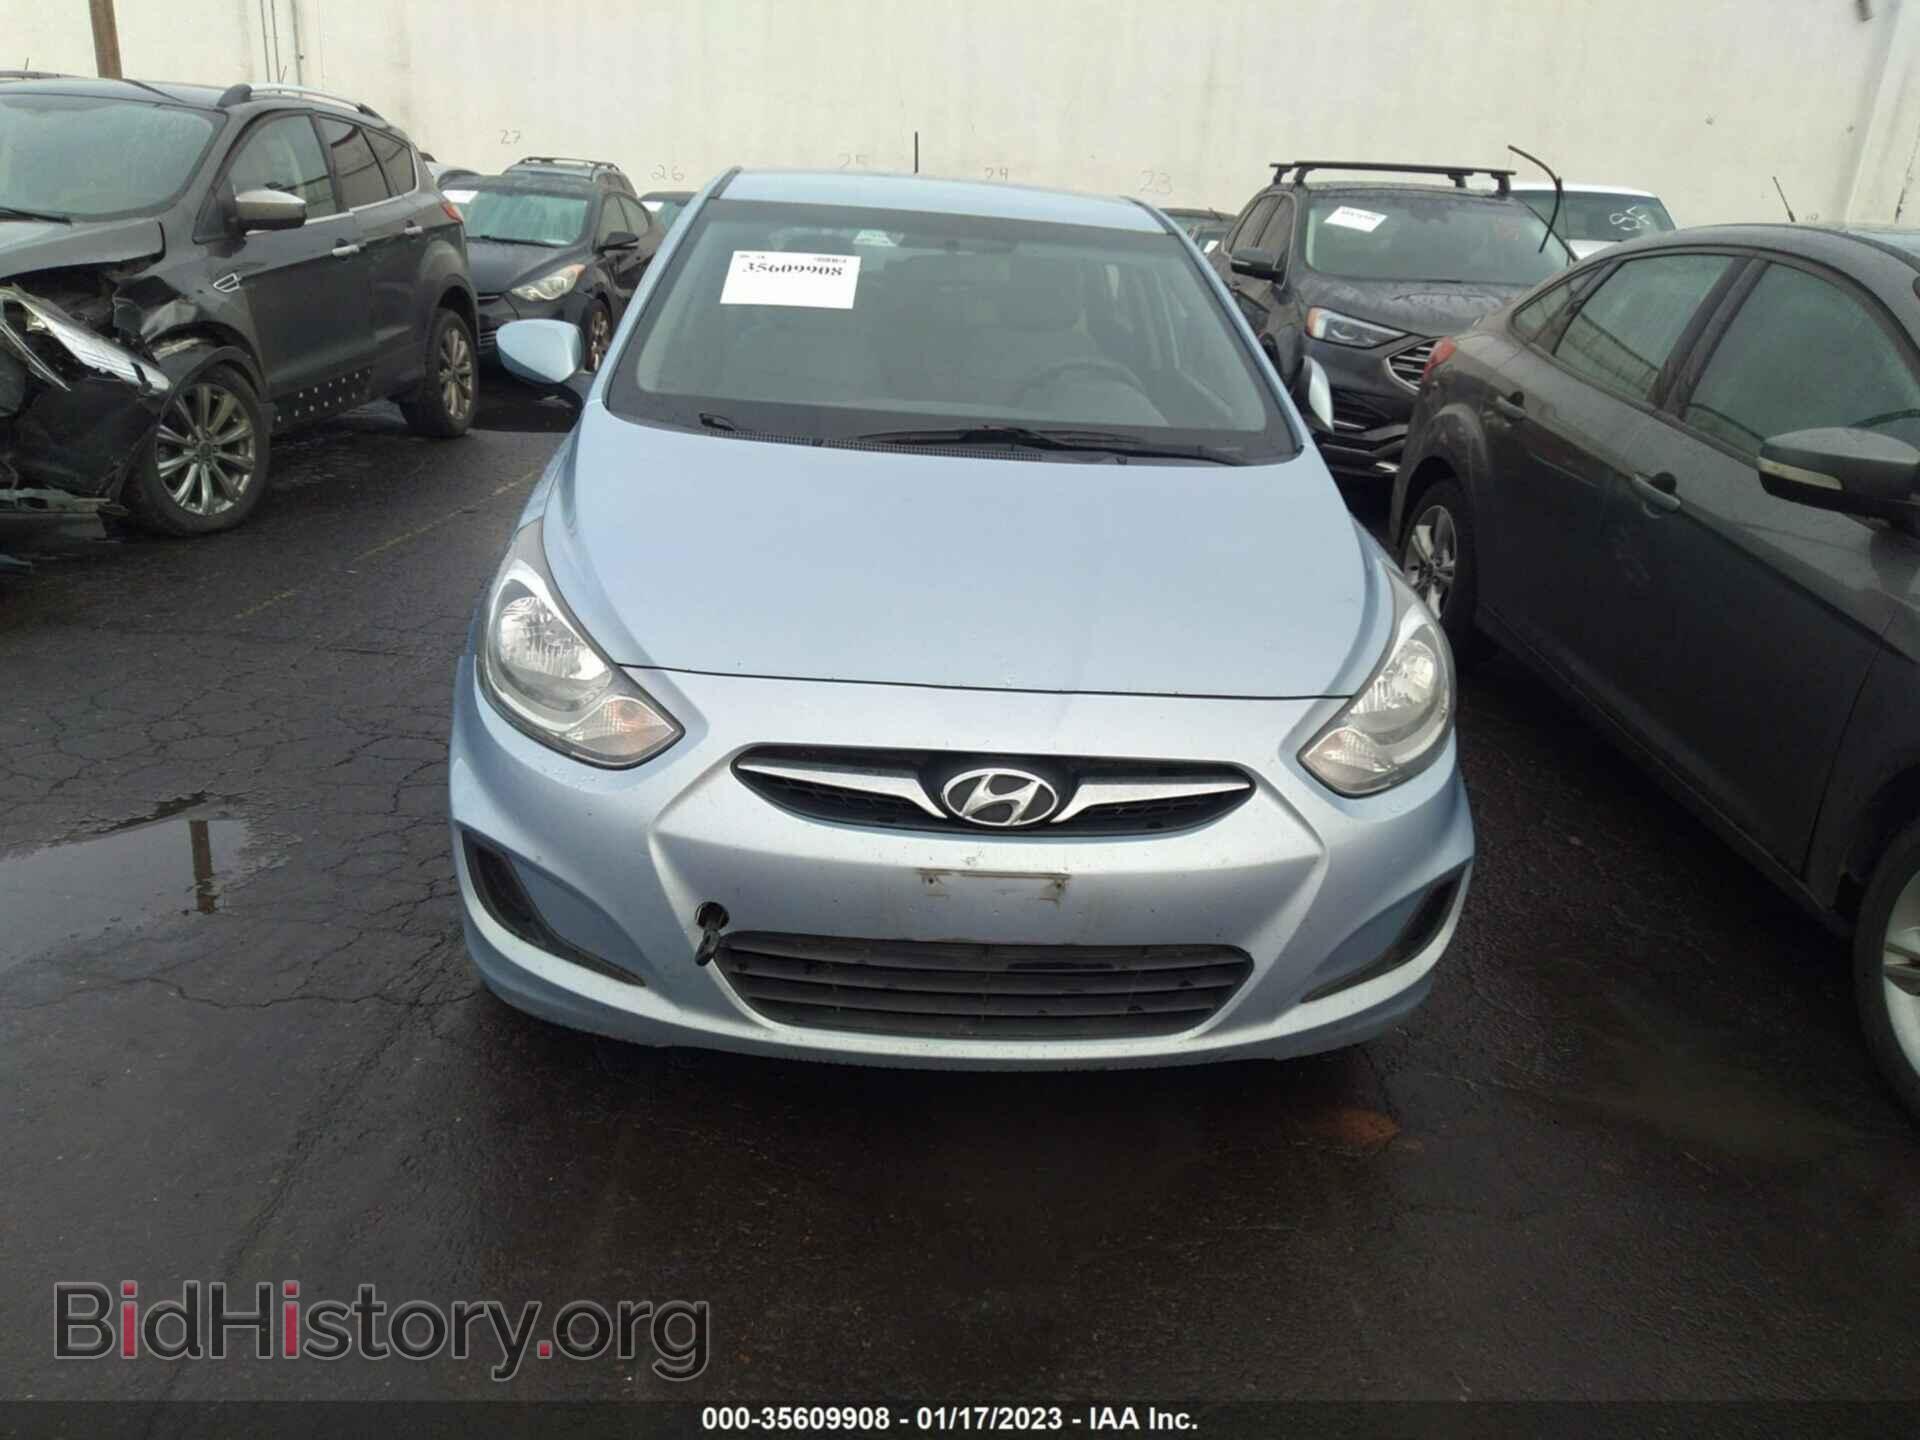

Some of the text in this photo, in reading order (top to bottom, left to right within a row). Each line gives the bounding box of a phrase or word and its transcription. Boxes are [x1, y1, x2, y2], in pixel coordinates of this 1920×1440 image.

[499, 129, 521, 145] 27
[651, 164, 685, 182] 26
[742, 262, 843, 276] 35609908
